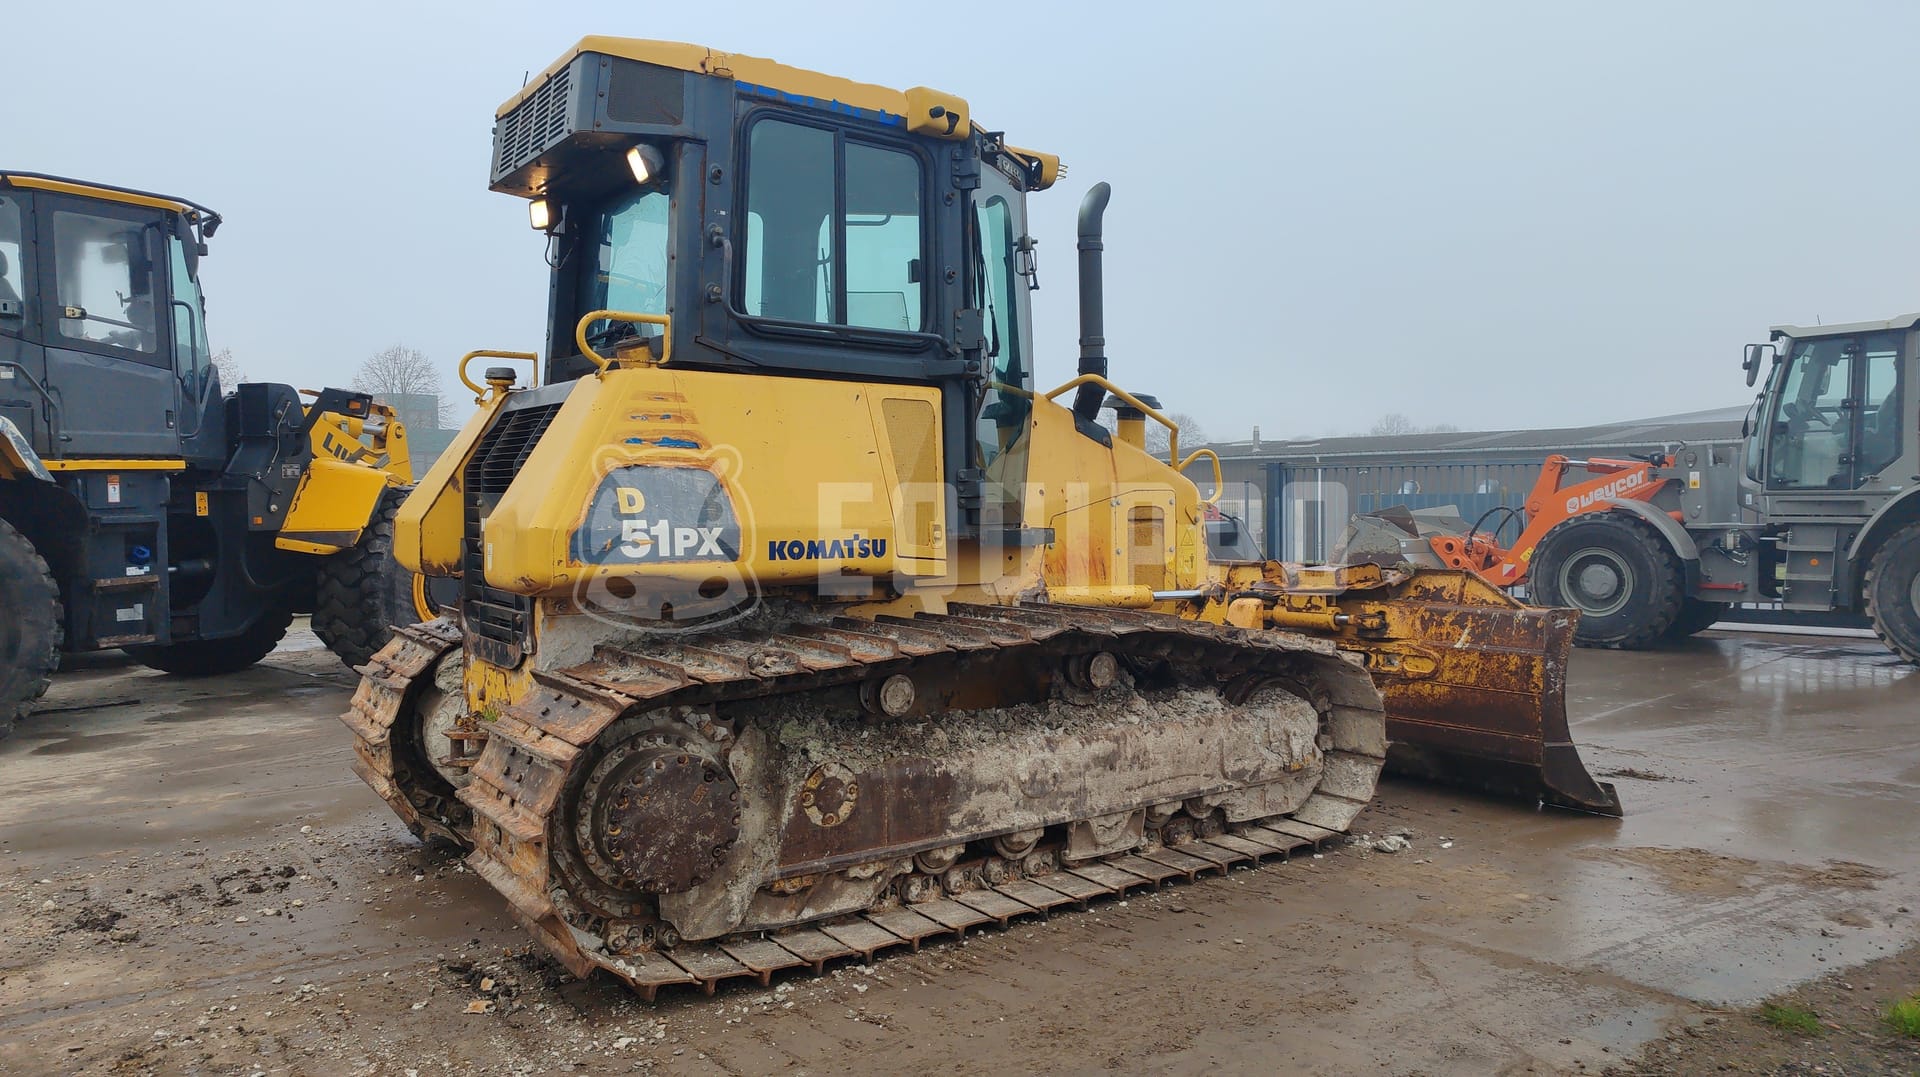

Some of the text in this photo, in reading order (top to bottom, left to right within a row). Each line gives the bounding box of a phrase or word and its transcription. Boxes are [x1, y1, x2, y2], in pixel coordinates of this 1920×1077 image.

[616, 487, 645, 514] D
[1580, 470, 1644, 508] weycor
[768, 533, 887, 560] KOMATSU
